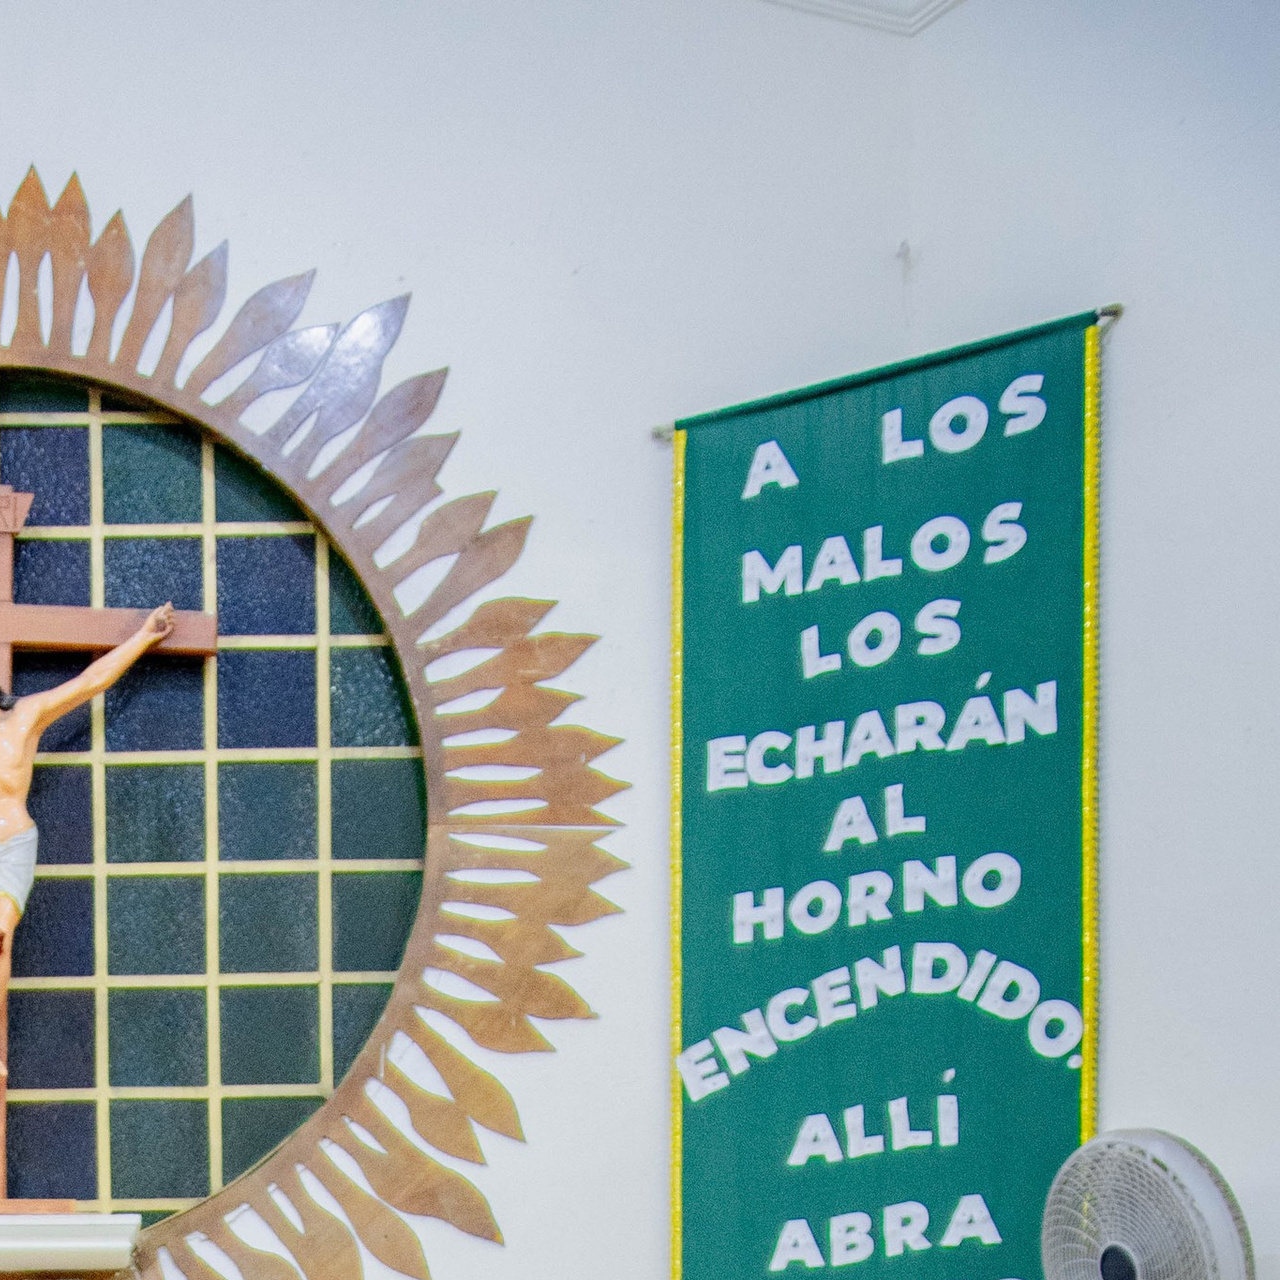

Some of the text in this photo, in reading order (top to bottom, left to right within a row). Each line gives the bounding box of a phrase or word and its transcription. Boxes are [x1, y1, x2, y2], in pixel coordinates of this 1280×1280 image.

[742, 374, 1046, 499] A LOS
[741, 501, 1027, 603] MALOS
[801, 598, 961, 679] LOS
[706, 672, 1058, 792] ECHARÁN
[823, 783, 926, 852] AL
[732, 852, 1022, 944] HORNO
[675, 941, 1083, 1102] ENCENDIDO.
[787, 1068, 960, 1166] ALLÍ
[769, 1194, 1002, 1272] ABRA
